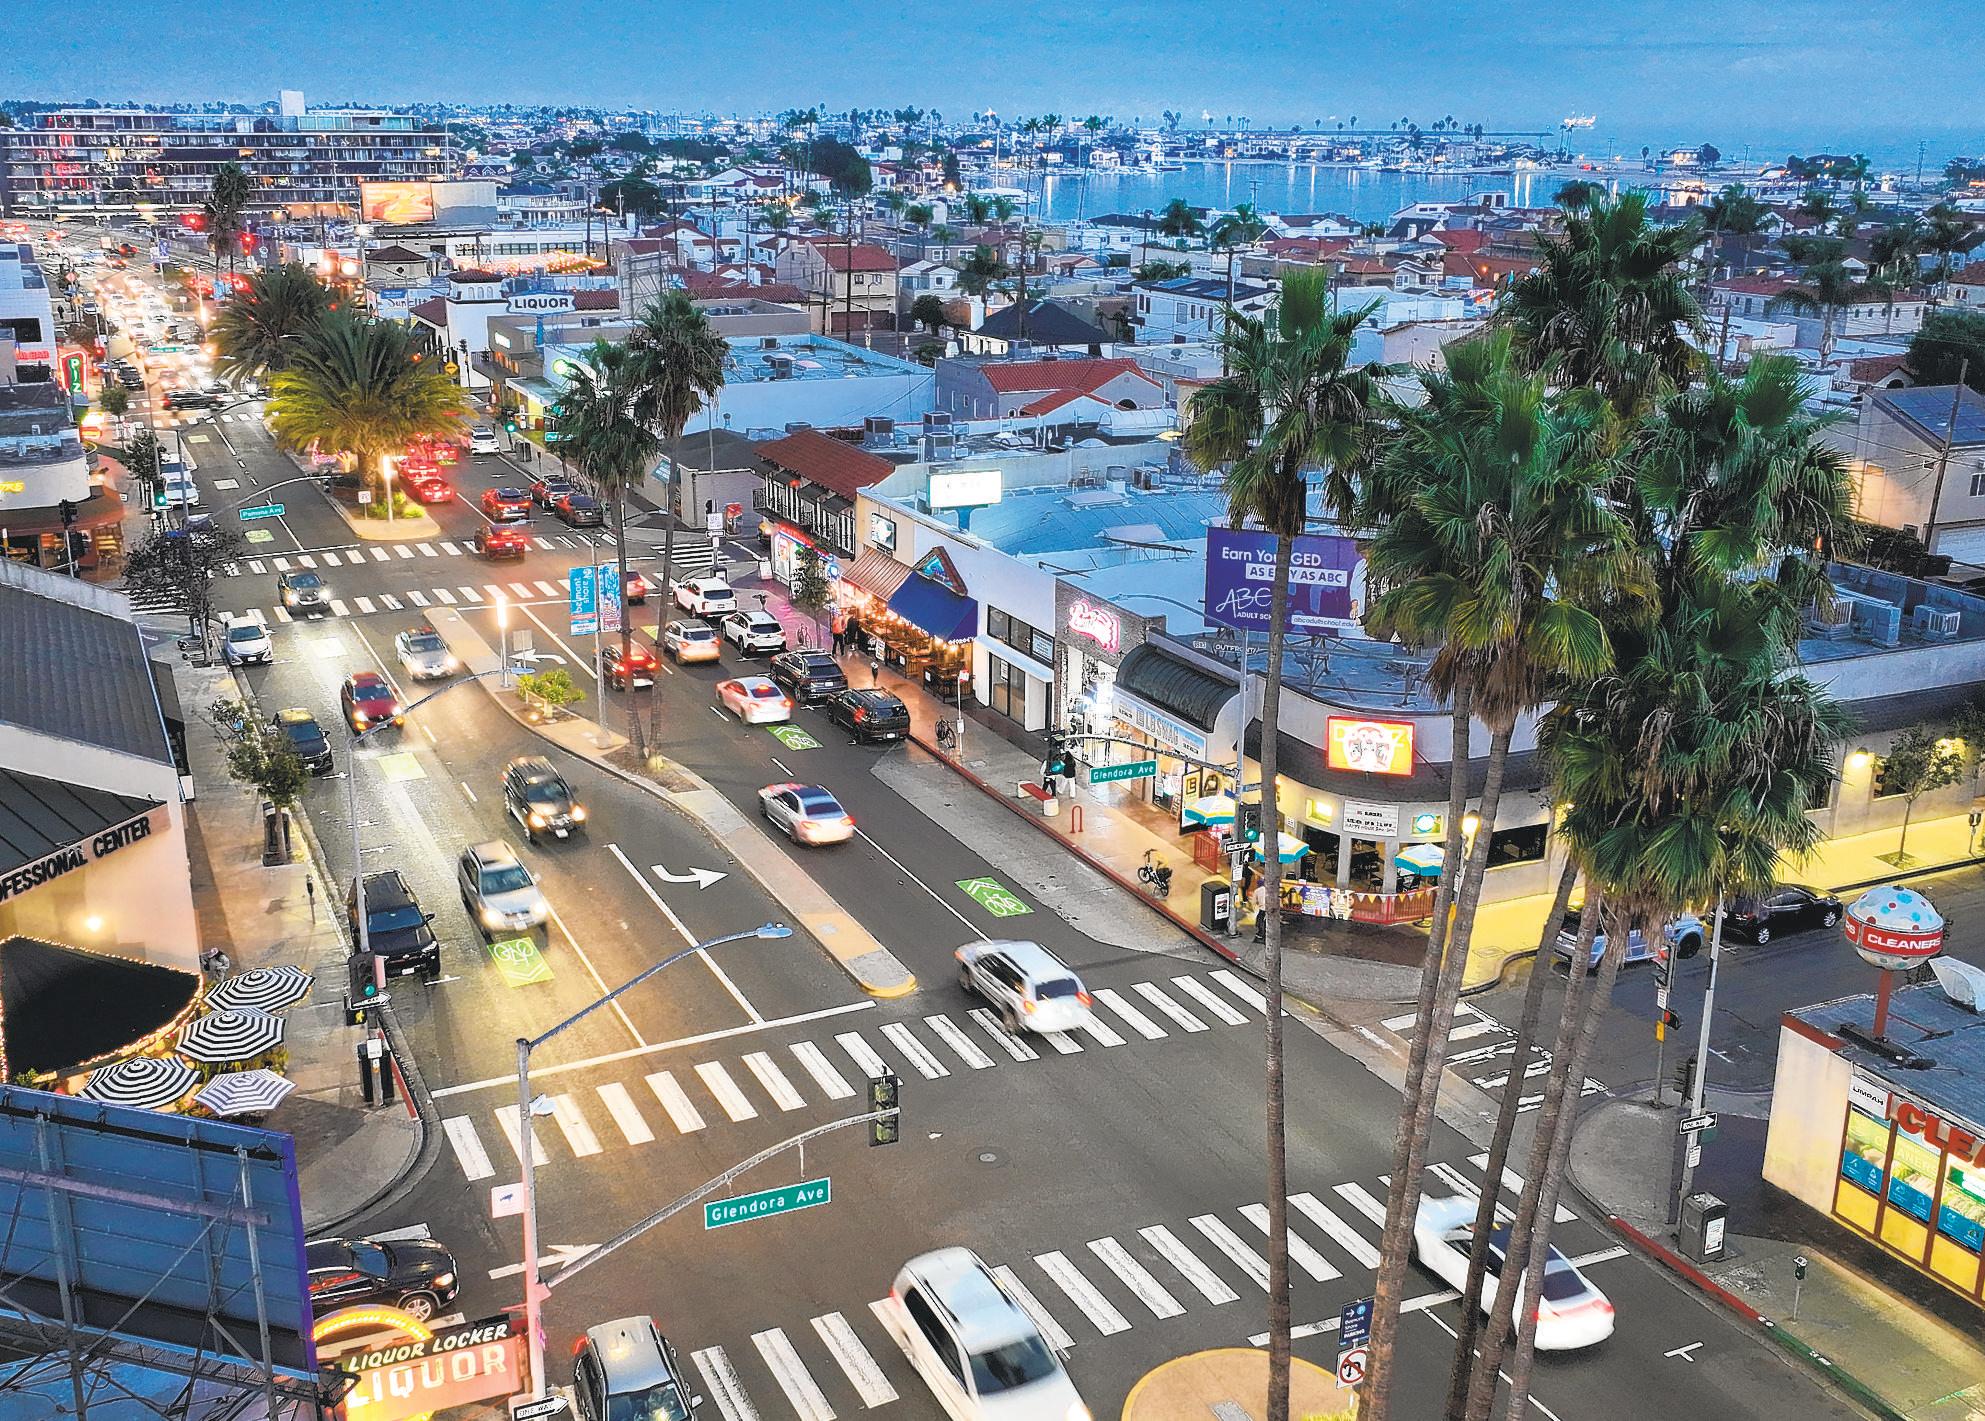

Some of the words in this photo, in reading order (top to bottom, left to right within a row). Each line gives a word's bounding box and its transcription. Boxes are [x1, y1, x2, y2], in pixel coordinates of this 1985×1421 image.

[514, 297, 569, 309] LIQUOR
[1221, 546, 1252, 561] Earn
[1256, 549, 1277, 564] Yo
[1290, 553, 1322, 566] GED
[1249, 567, 1265, 576] AS
[1268, 567, 1297, 579] EY
[1300, 570, 1316, 581] AS
[1318, 572, 1343, 583] ABC
[574, 577, 583, 613] belmont
[582, 580, 590, 604] shore
[1236, 611, 1258, 620] ADULT
[1093, 769, 1133, 780] Glendora
[1138, 764, 1154, 774] Ave
[92, 816, 151, 858] CENTER
[1867, 933, 1941, 950] CLEANERS
[711, 1196, 785, 1221] Glendora
[796, 1188, 824, 1203] Ave
[347, 1342, 425, 1373] LIQUOR
[431, 1322, 508, 1351] LOCKER
[345, 1343, 507, 1409] LIQUOR
[518, 1407, 535, 1417] ONE
[537, 1403, 554, 1413] WAY
